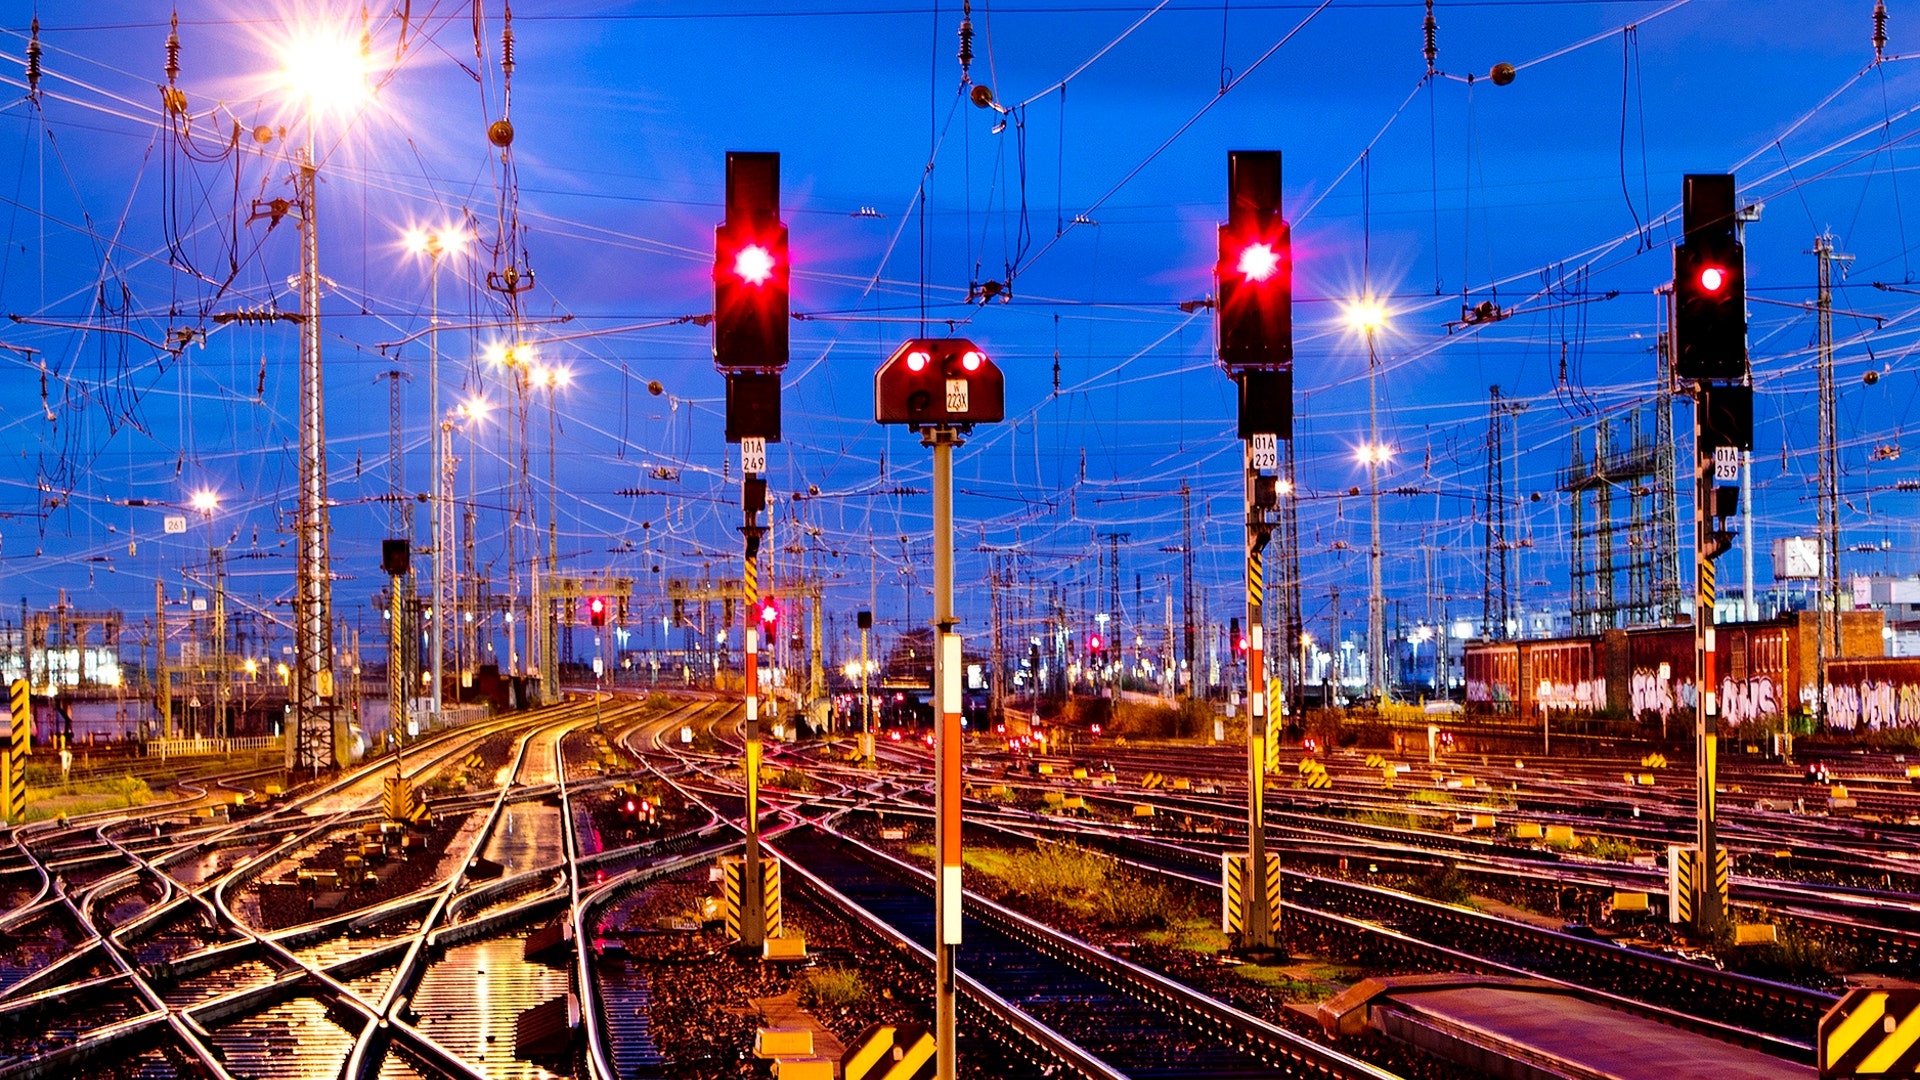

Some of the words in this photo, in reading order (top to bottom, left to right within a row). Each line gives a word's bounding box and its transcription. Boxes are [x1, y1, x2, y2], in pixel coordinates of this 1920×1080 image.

[743, 440, 763, 454] 01A
[1255, 437, 1275, 450] 01A
[1255, 453, 1276, 467] 229
[1717, 449, 1737, 462] 01A
[743, 457, 764, 471] 249
[1717, 464, 1737, 478] 259
[168, 520, 184, 531] 261
